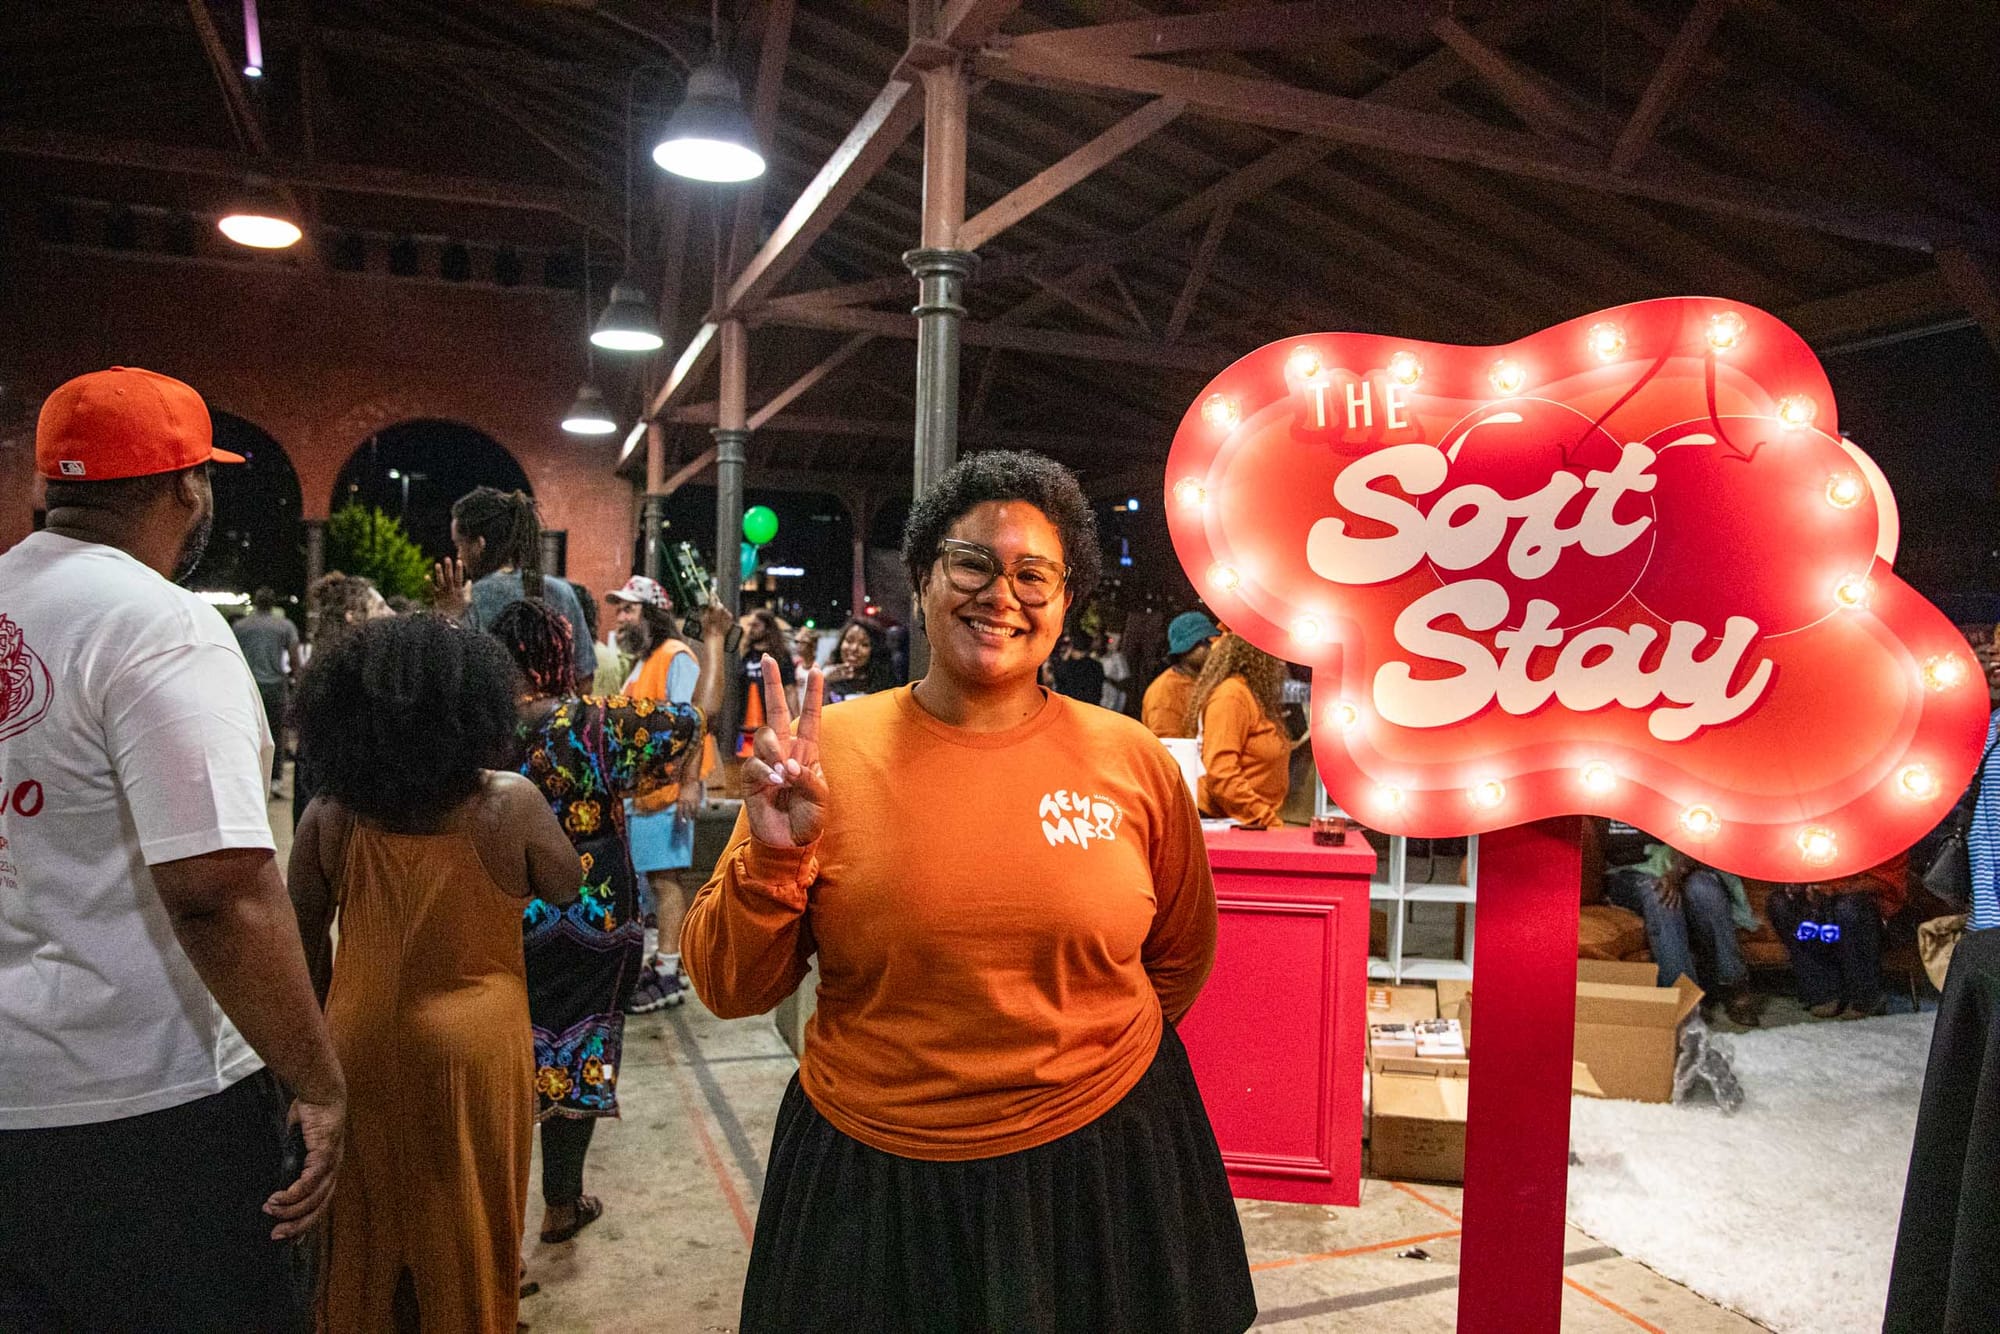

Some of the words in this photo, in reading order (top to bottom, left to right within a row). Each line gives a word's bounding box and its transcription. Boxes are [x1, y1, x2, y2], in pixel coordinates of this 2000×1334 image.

[1308, 381, 1408, 429] THE
[1307, 442, 1657, 584] Soft
[1373, 579, 1773, 741] Stay
